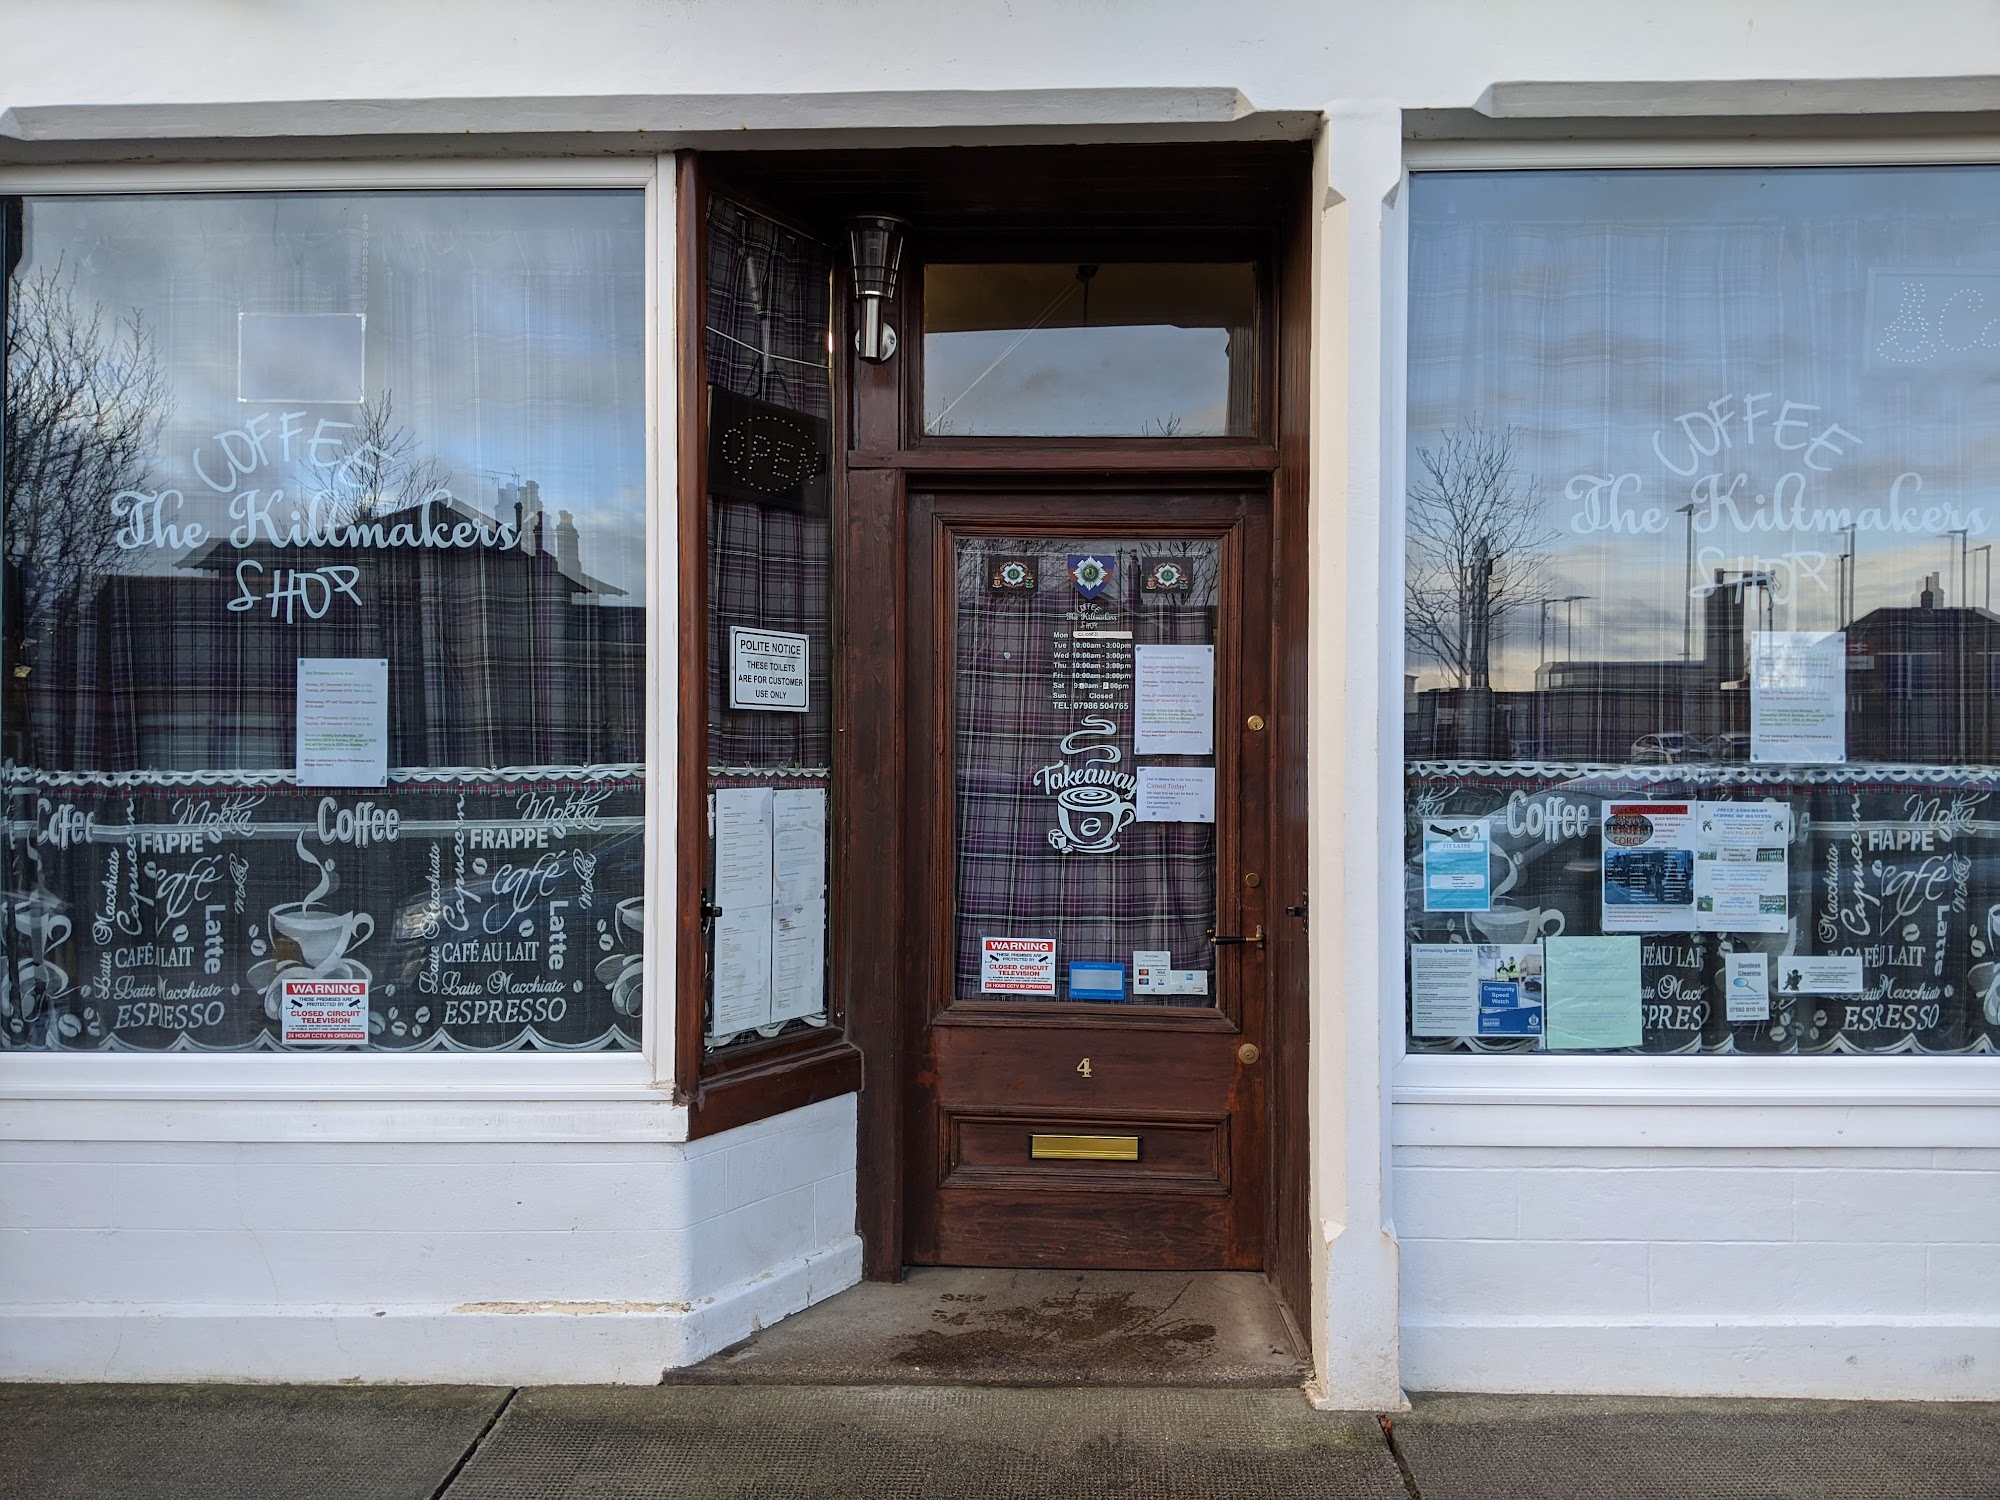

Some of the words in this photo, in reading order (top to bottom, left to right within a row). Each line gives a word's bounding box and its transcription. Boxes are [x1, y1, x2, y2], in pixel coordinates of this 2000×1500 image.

[1652, 391, 1863, 477] COFFEE
[192, 410, 396, 494] COFFEE
[721, 427, 817, 485] OPEN
[1563, 473, 1669, 536] The
[110, 489, 211, 550] The
[1688, 546, 1829, 610] SHOP
[226, 558, 363, 625] SHOP
[740, 639, 770, 652] POLITE
[771, 643, 801, 655] NOTICE
[1106, 642, 1132, 650] 3:00pm
[1106, 652, 1132, 660] 3:00pm
[746, 660, 769, 670] THESE
[769, 662, 796, 673] TOILETS
[1106, 662, 1132, 670] 3:00pm
[1106, 672, 1132, 680] 3:00pm
[738, 673, 752, 683] ARE
[753, 675, 768, 684] FOR
[768, 676, 804, 687] CUSTOMER
[755, 689, 769, 698] USE
[769, 690, 787, 699] ONLY
[1033, 760, 1139, 800] Takeaway
[316, 796, 401, 848] Coffee
[515, 790, 613, 832] Mokka
[1506, 789, 1591, 844] Coffee
[1614, 806, 1662, 814] RECRUITING
[469, 827, 549, 850] FRAPPE
[1613, 836, 1645, 846] FORCE
[91, 847, 120, 945] Macchiato
[1818, 843, 1839, 944] Macchiato
[205, 904, 227, 975] Latte
[548, 900, 569, 971] Latte
[990, 942, 1049, 951] WARNING
[114, 942, 155, 968] CAFÉ
[160, 946, 195, 967] LAIT
[441, 939, 480, 963] CAFÉ
[481, 943, 504, 962] AU
[506, 941, 540, 961] LAIT
[1676, 946, 1701, 968] LAI
[1887, 945, 1927, 967] LAIT
[92, 950, 113, 1000] Latte
[418, 946, 440, 994] Latte
[441, 970, 483, 996] Latte
[486, 970, 567, 996] Macchiato
[113, 975, 157, 1000] Latte
[292, 984, 360, 994] WARNING
[442, 996, 568, 1025] ESPRESSO
[1076, 1057, 1092, 1078] 4
